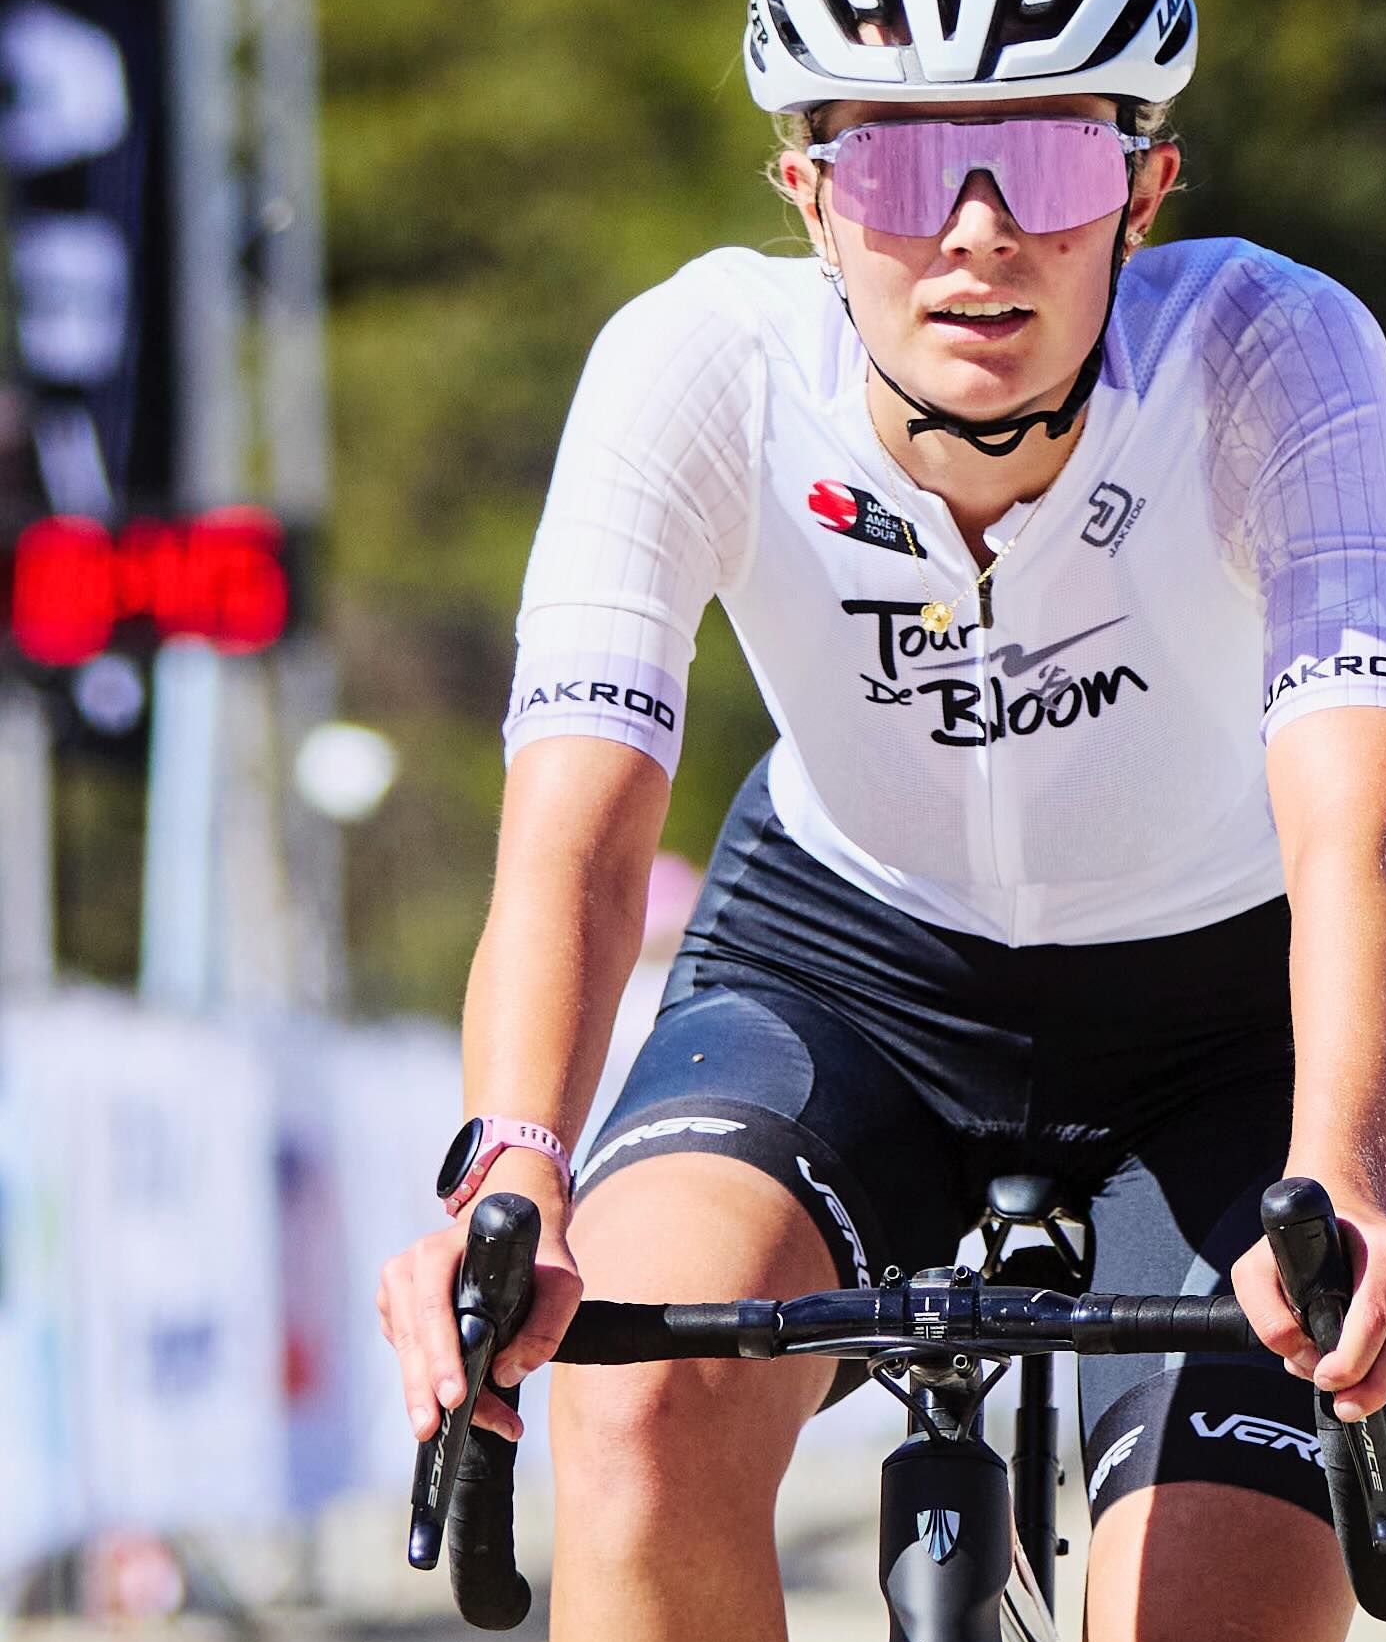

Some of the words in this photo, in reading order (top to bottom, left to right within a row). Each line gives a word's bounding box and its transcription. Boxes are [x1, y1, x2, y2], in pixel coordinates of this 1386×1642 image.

[865, 514, 902, 532] AMER
[866, 501, 891, 517] UC
[1109, 497, 1147, 558] JAKROO
[865, 523, 897, 543] TOUR
[841, 599, 981, 681] Tour
[860, 673, 913, 706] De
[917, 665, 1149, 747] Bloom
